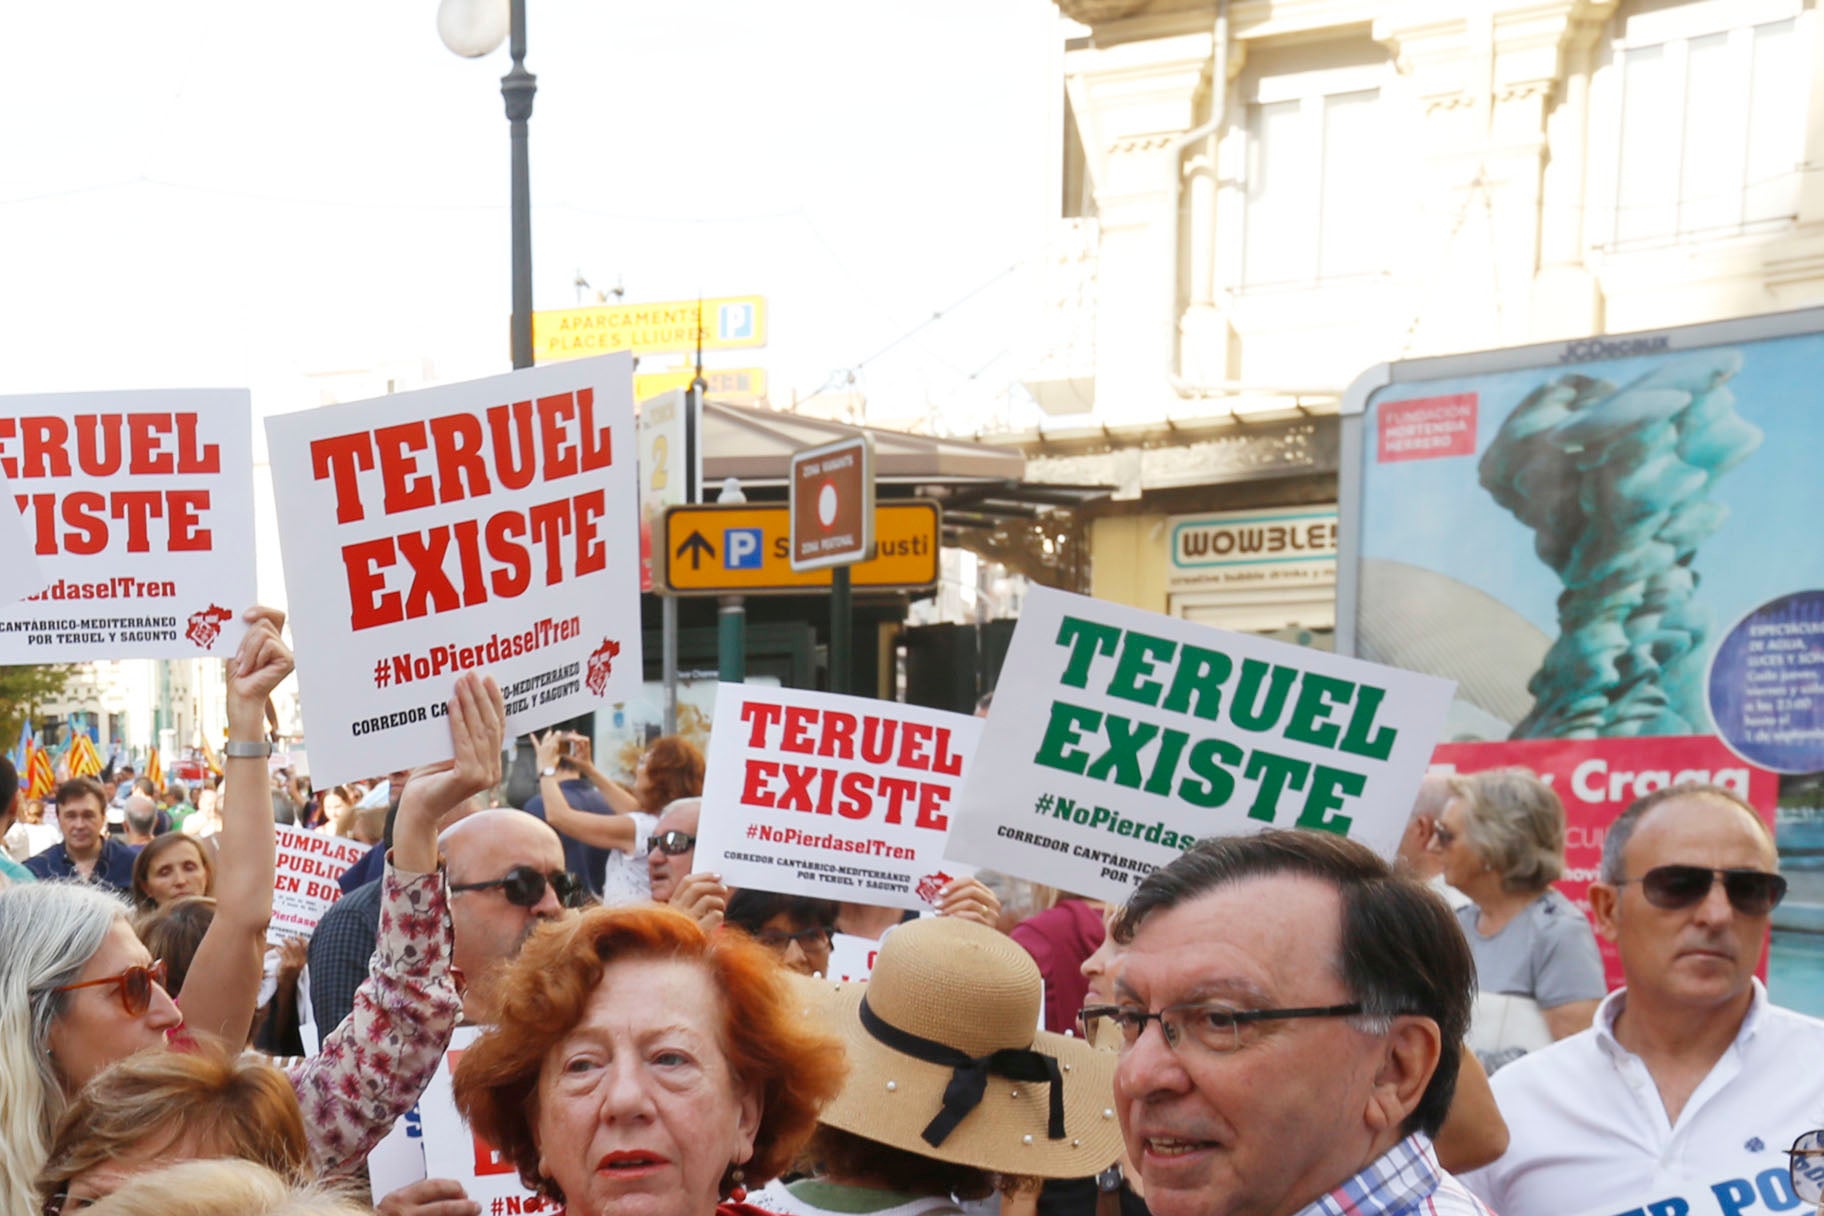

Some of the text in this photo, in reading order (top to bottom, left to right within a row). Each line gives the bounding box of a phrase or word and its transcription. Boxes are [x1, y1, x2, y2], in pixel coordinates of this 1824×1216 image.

[560, 307, 702, 332] APARCAMENTS
[549, 325, 711, 351] PLACES LLIURES
[310, 387, 612, 525] TERUEL
[14, 490, 212, 556] ISTE
[341, 489, 606, 631] EXISTE
[729, 532, 756, 565] P
[875, 533, 928, 561] usti
[28, 631, 177, 645] POR TERUEL Y SAGUNTO
[374, 616, 580, 689] #NoPierdaselTren
[540, 682, 580, 704] SAGUNTO
[1054, 614, 1397, 762] TERUEL
[352, 706, 427, 736] CORREDOR
[740, 701, 963, 777] TERUEL
[1033, 700, 1368, 836] EXISTE
[740, 759, 952, 831] EXISTE
[746, 823, 916, 861] #NoPierdaselTren
[997, 825, 1070, 853] CORREDOR
[723, 850, 774, 865] CORREDOR
[275, 874, 301, 893] EN
[796, 871, 816, 882] POR
[819, 873, 855, 886] TERUEL
[866, 879, 909, 893] SAGUNTO
[1100, 867, 1128, 884] POR
